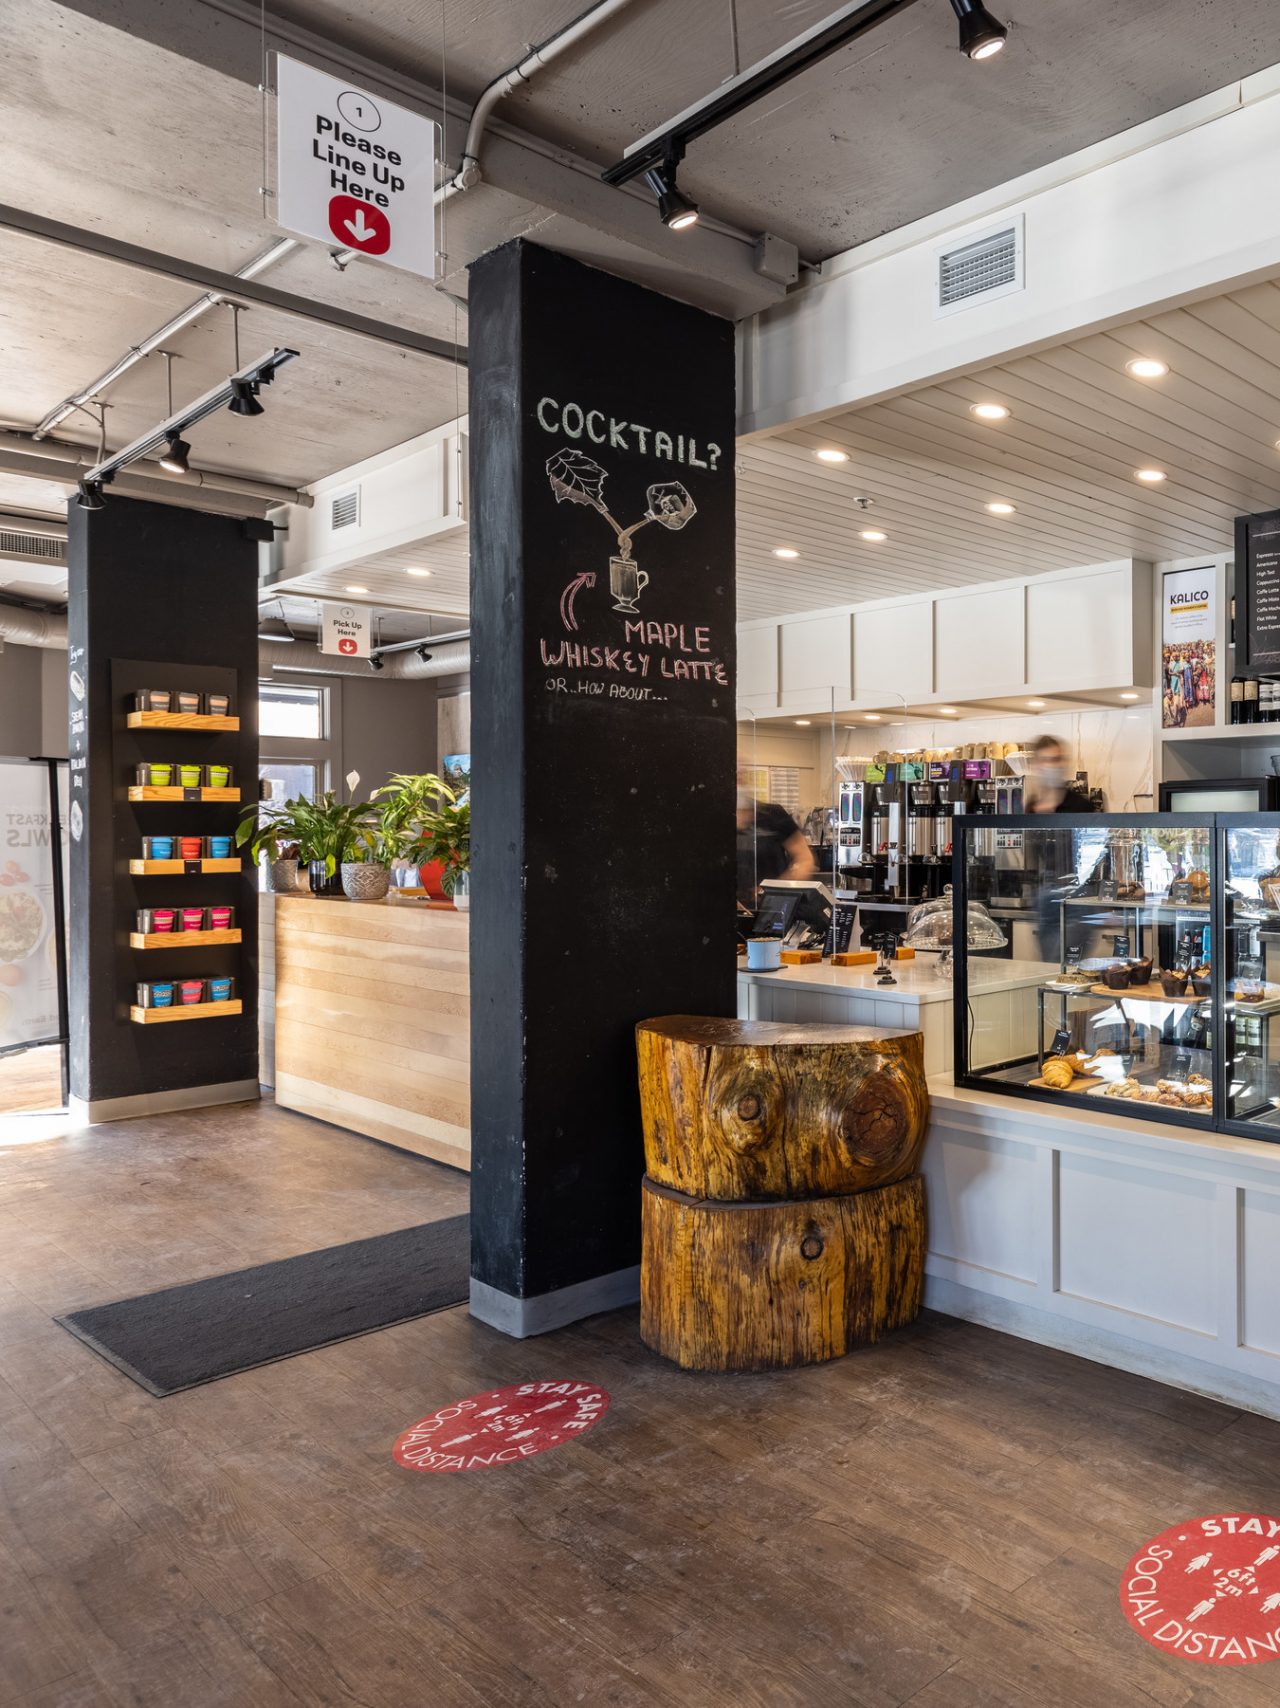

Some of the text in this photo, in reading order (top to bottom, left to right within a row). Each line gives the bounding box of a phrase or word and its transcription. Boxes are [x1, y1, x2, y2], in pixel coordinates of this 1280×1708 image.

[316, 114, 402, 166] Please
[313, 138, 405, 192] Line Up
[330, 169, 389, 208] Here
[537, 397, 722, 471] COCKTAIL?
[1170, 590, 1209, 605] KALICO
[352, 622, 362, 630] Up
[625, 620, 710, 653] MAPLE
[539, 638, 729, 686] WHISKEY LATTE
[516, 1382, 602, 1429] STAY SAFE
[401, 1400, 539, 1469] SOCIAL DISTANCE
[1128, 1545, 1173, 1626] SOCIAL
[1213, 1577, 1243, 1597] 2m
[1227, 1568, 1256, 1586] 6ft
